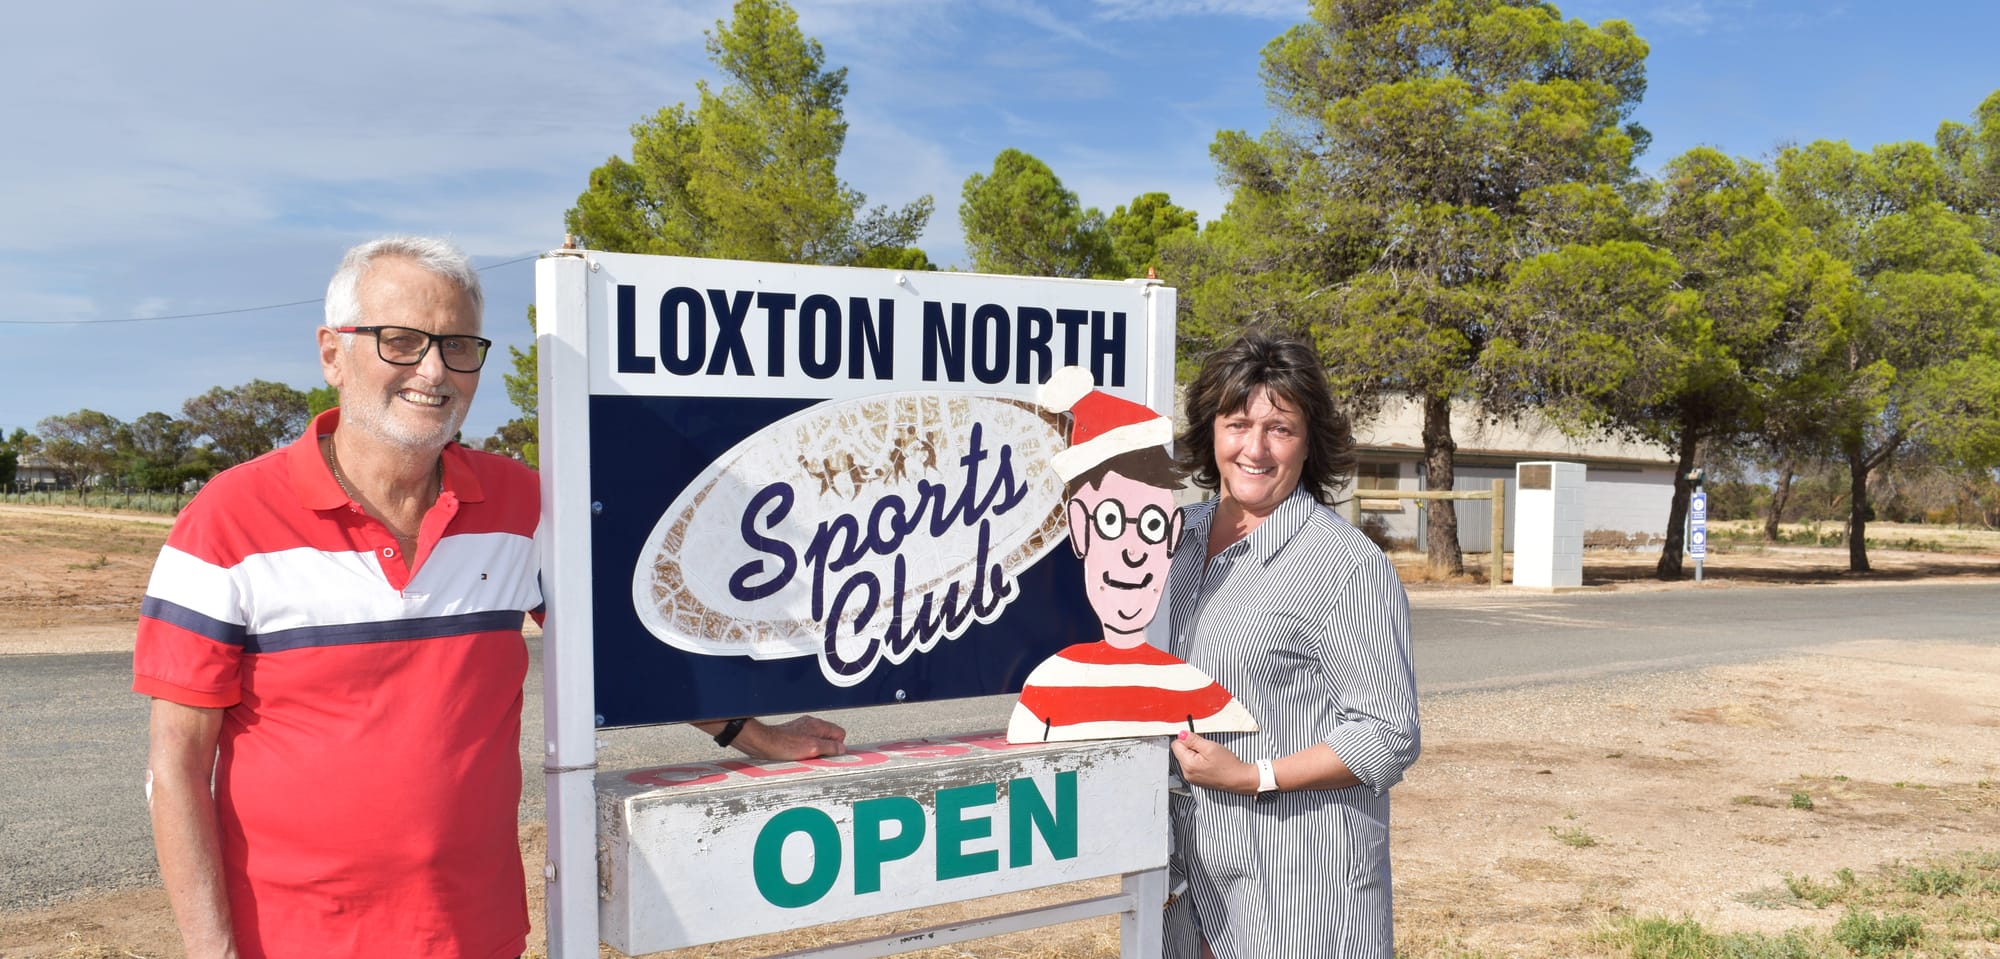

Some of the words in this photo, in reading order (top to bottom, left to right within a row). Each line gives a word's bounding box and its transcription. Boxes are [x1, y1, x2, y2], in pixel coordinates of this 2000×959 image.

[616, 284, 895, 380] LOXTON
[921, 300, 1127, 387] NORTH
[728, 422, 1029, 622] Sports
[824, 518, 1012, 676] Club
[753, 770, 1079, 908] OPEN
